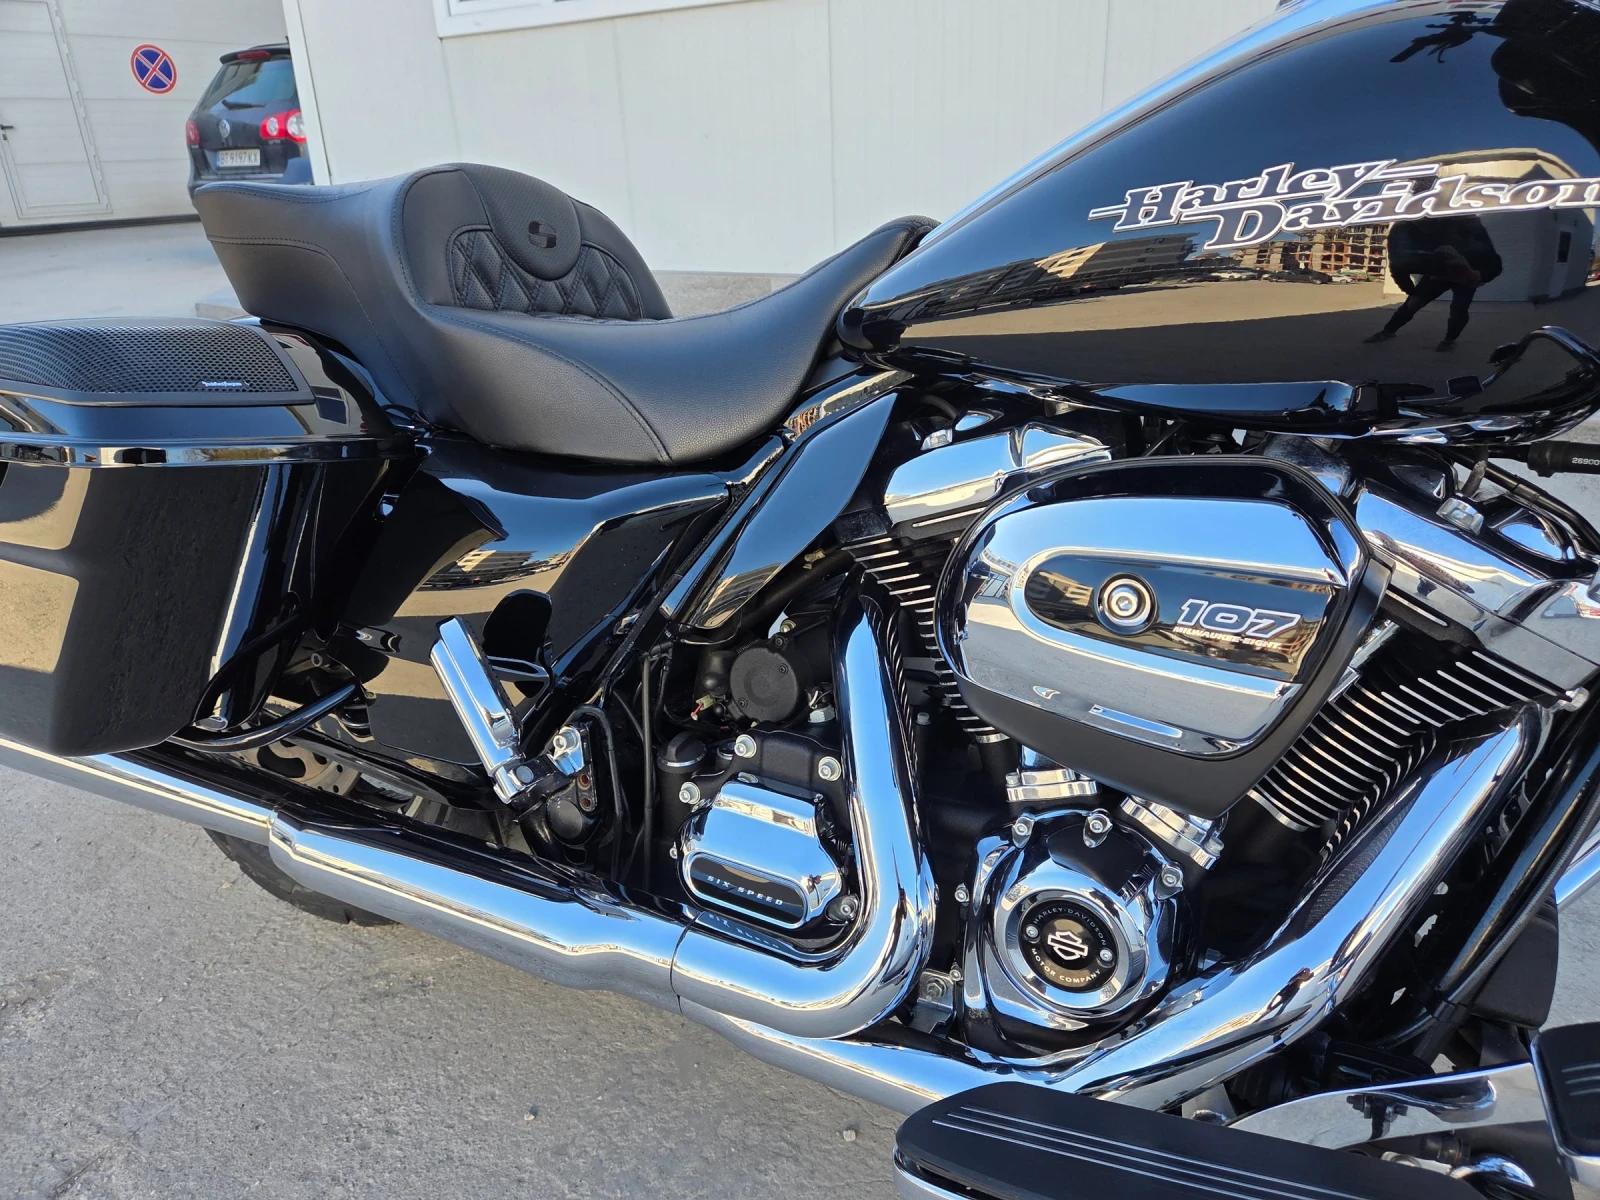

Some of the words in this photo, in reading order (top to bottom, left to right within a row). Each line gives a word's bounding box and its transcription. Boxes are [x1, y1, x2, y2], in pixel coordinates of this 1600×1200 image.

[1177, 598, 1302, 638] 107
[707, 875, 731, 888] SIX
[737, 886, 783, 906] SPEED
[1031, 947, 1057, 977] MOTOR
[1059, 968, 1101, 983] COMPANY
